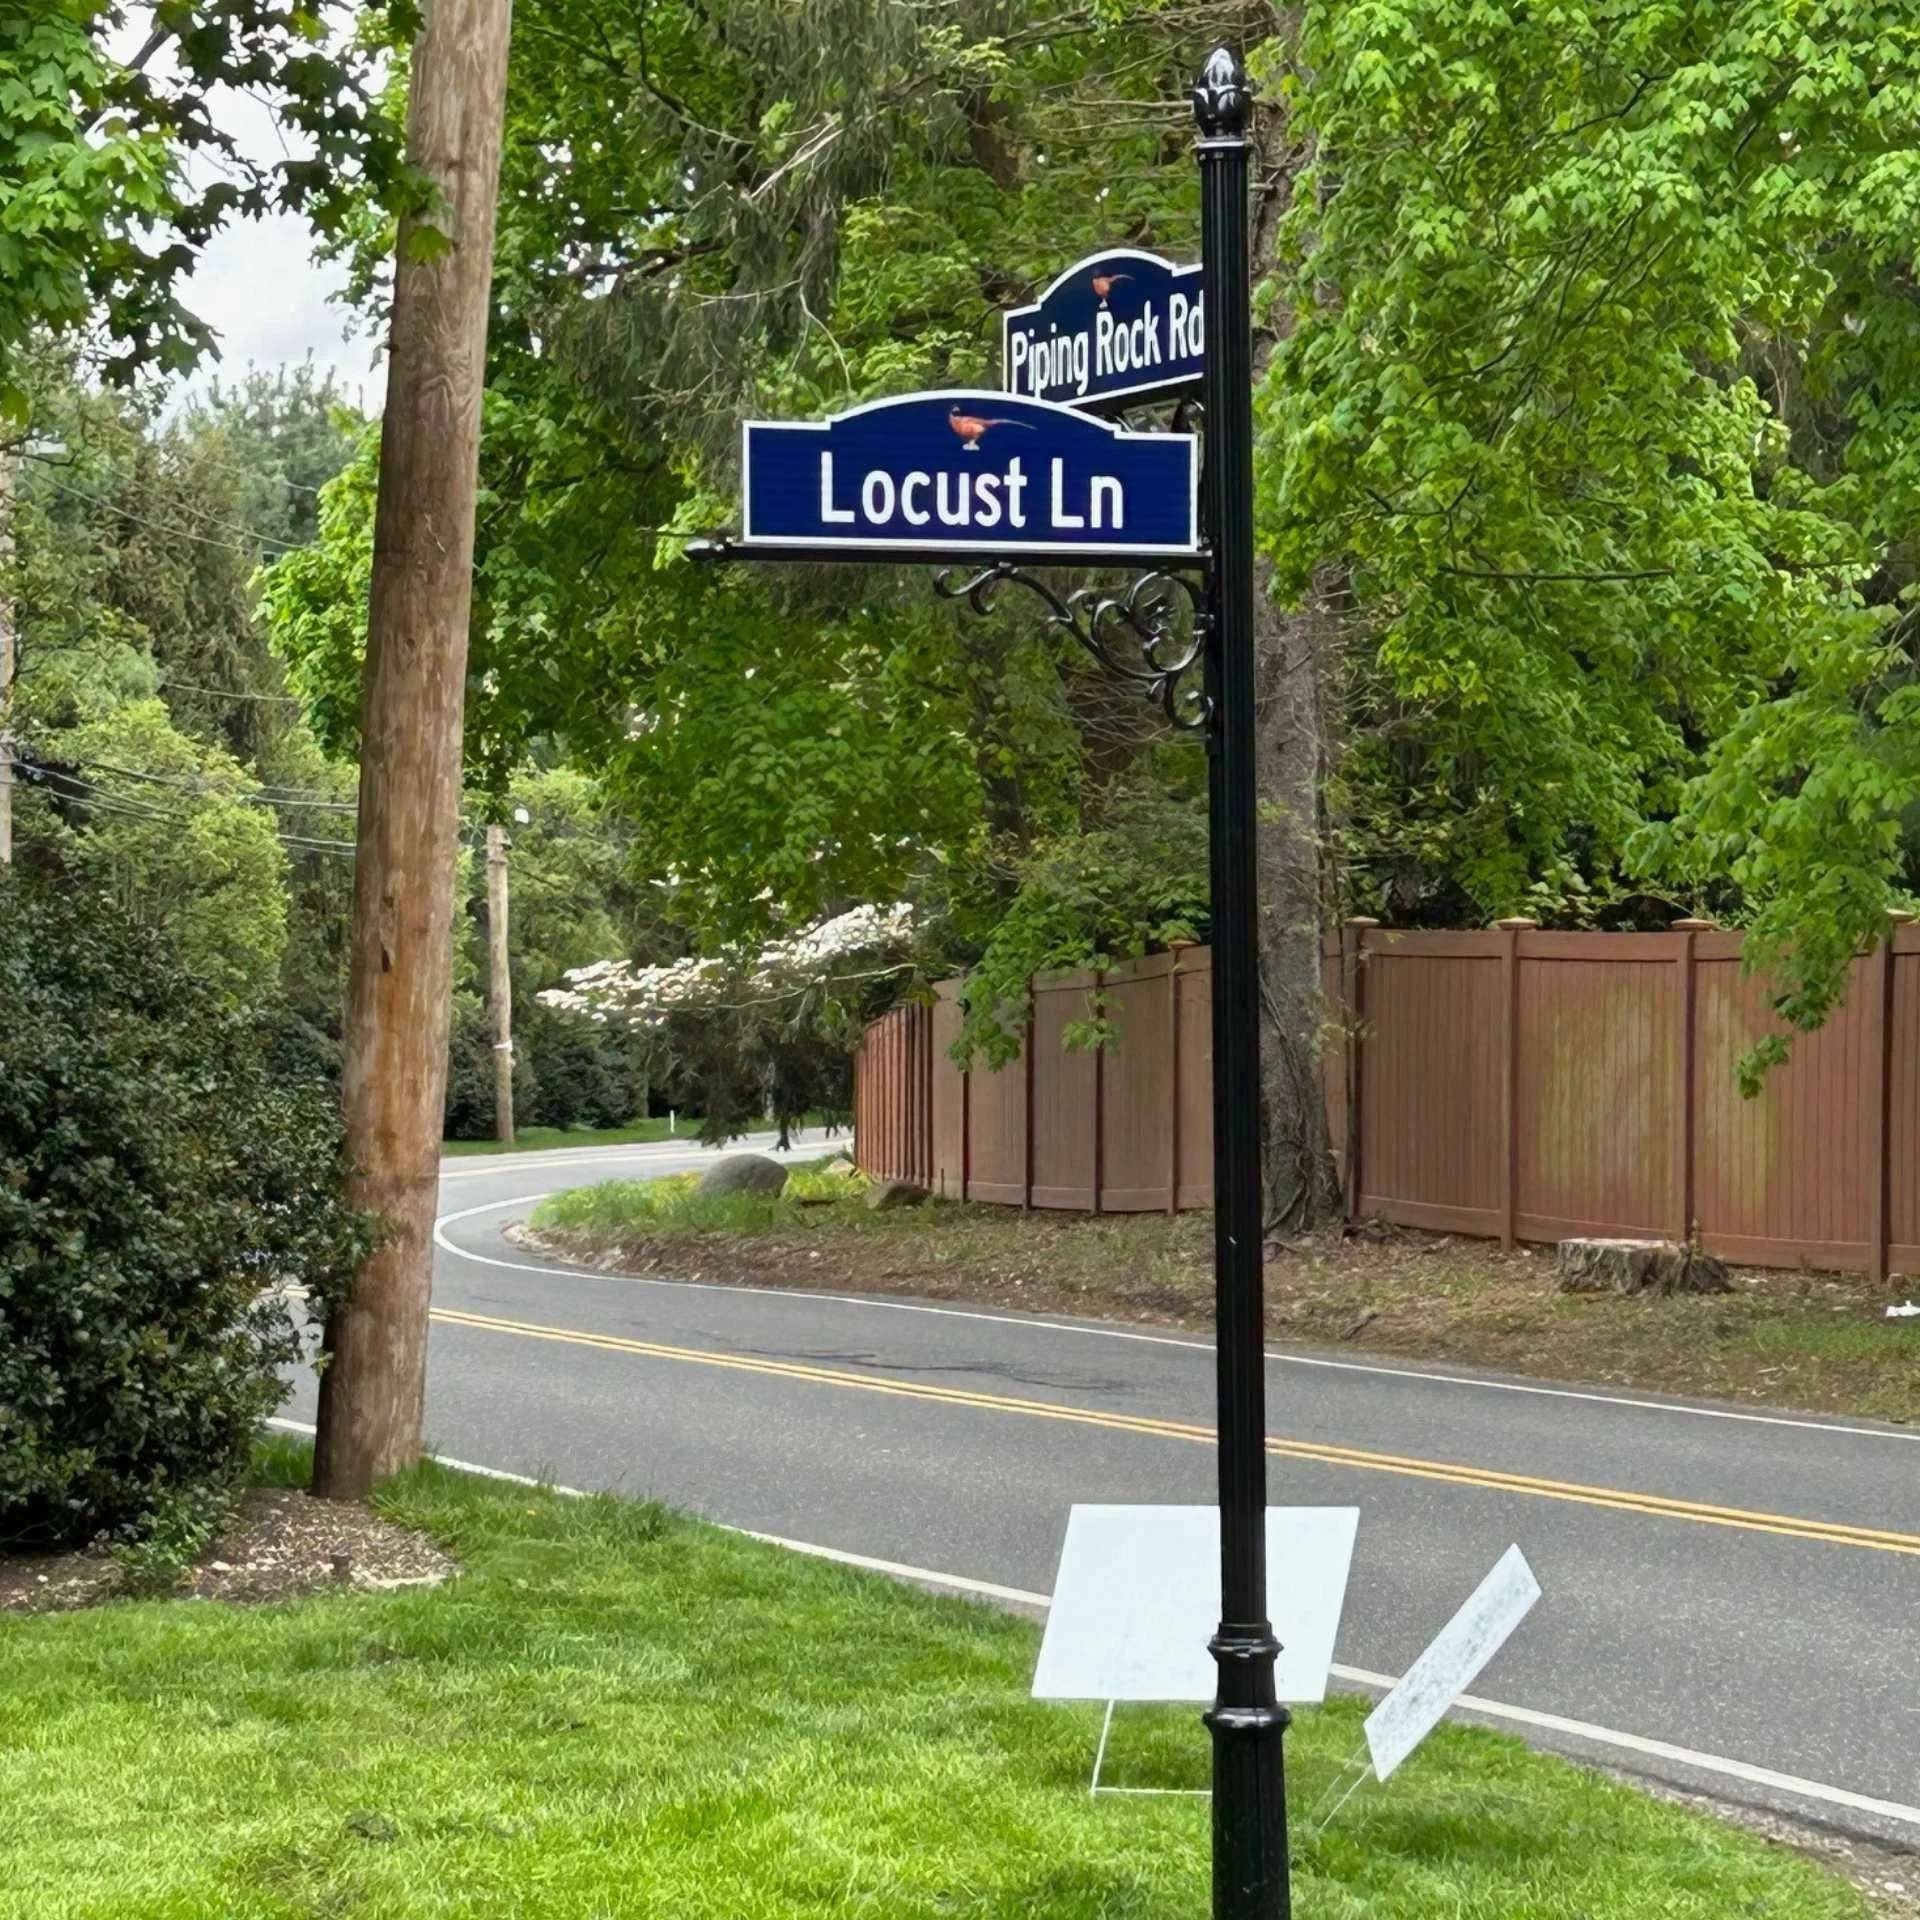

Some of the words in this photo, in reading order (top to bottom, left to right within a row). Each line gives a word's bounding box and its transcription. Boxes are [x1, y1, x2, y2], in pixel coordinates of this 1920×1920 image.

[1011, 323, 1089, 400] Piping
[1096, 300, 1162, 377] Rock
[1169, 289, 1205, 361] Rd
[821, 451, 1028, 529] Locust
[1051, 457, 1124, 529] Ln
